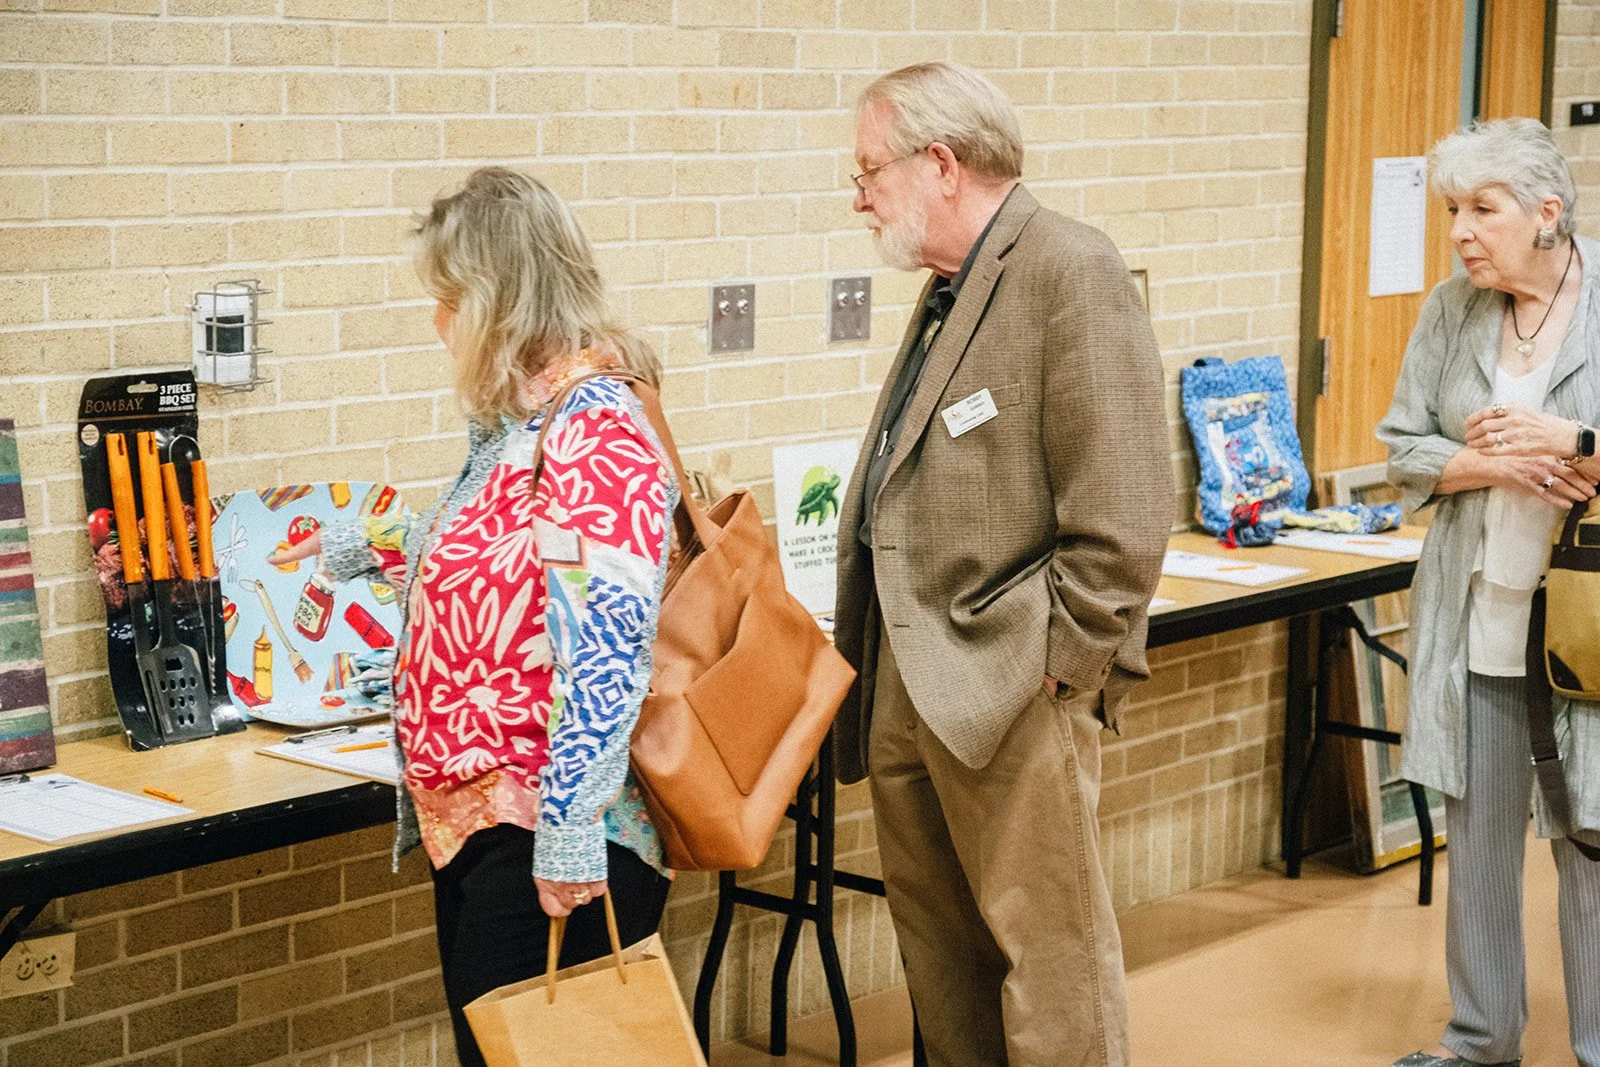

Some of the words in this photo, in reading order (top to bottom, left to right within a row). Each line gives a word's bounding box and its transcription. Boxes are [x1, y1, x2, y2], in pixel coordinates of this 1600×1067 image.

[160, 385, 166, 395] 3
[167, 383, 192, 394] PIECE
[159, 395, 180, 406] BBQ
[180, 393, 196, 404] SET
[85, 398, 143, 414] BOMBAY
[791, 536, 816, 546] LESSON
[818, 534, 828, 542] ON
[789, 549, 806, 557] MAKE
[794, 558, 823, 570] STUFFED
